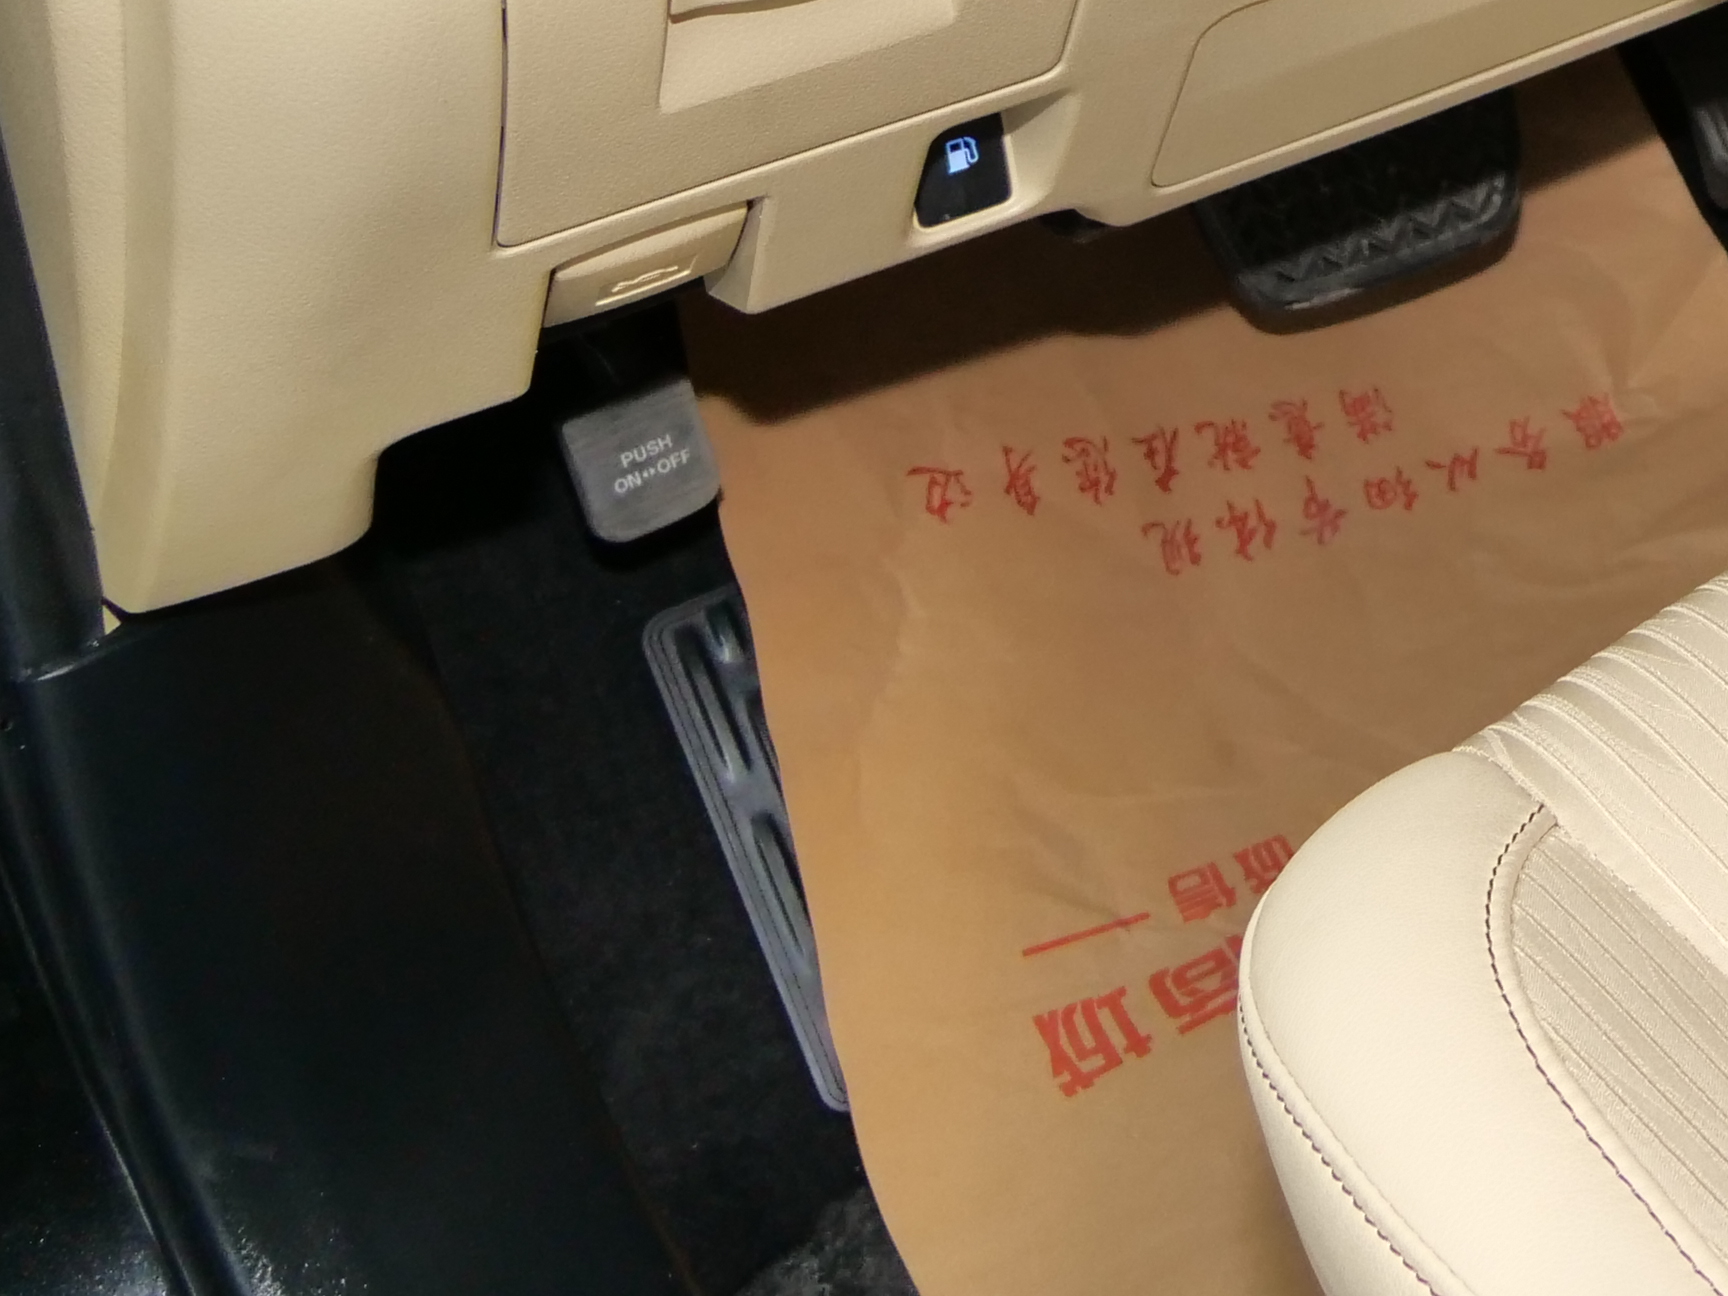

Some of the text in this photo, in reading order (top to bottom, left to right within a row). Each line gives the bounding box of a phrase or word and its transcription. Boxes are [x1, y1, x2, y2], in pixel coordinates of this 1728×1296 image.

[614, 448, 690, 494] ON OFF
[620, 434, 673, 468] PUSH
[909, 390, 1391, 522] 满意就在您身边
[1144, 398, 1622, 575] 服务从细节体现
